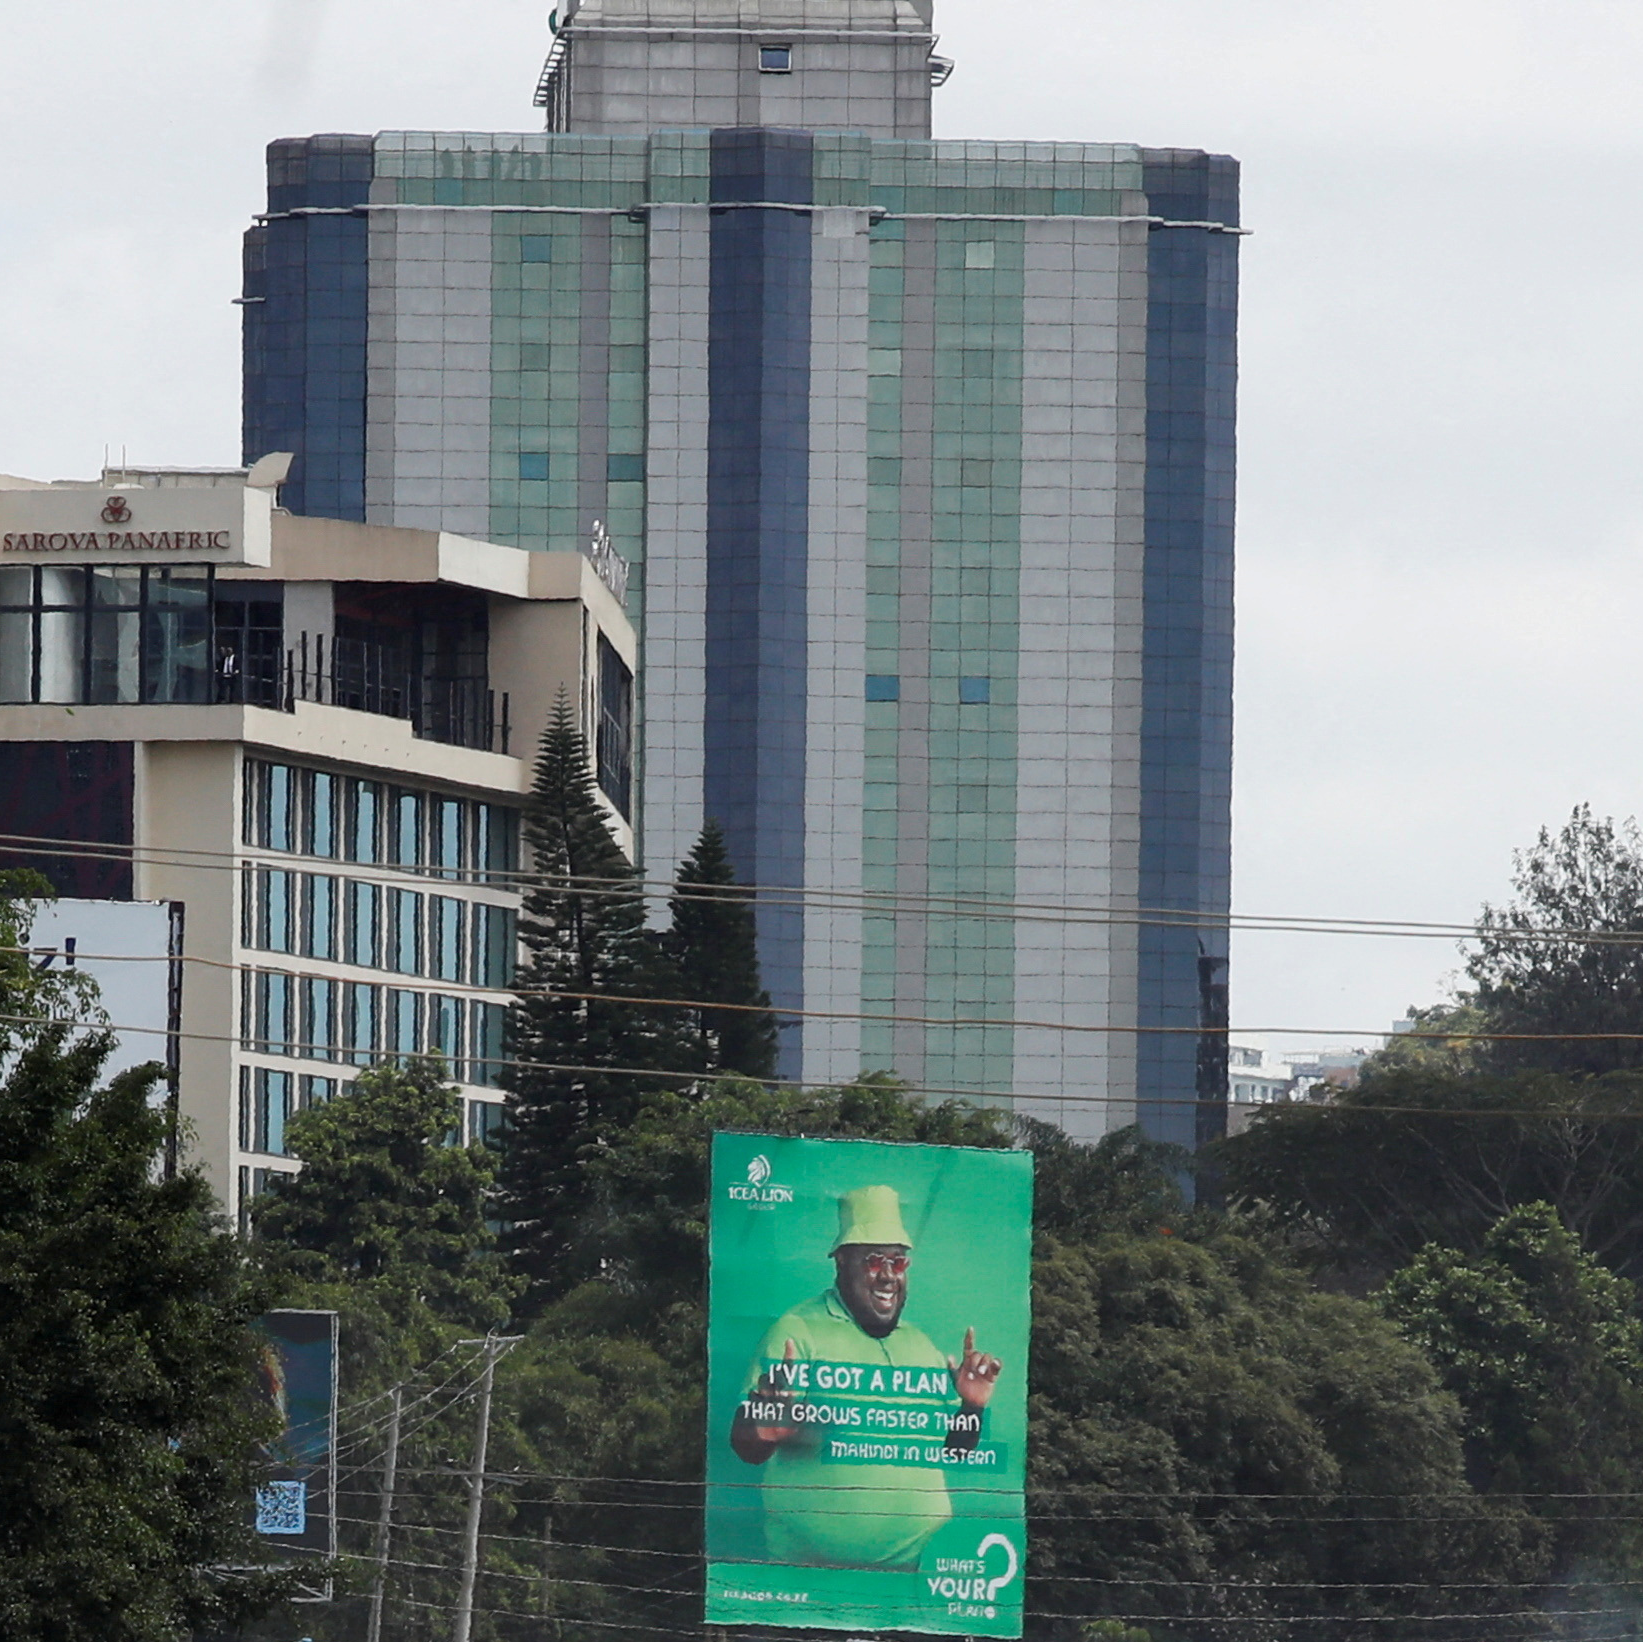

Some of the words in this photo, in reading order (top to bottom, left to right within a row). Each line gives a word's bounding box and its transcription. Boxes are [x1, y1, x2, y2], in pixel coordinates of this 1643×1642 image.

[3, 532, 101, 551] SAROVA
[103, 530, 230, 550] PANAFRIC
[728, 1187, 758, 1200] ICEA
[761, 1189, 793, 1202] LION
[769, 1363, 809, 1388] I'VE
[817, 1366, 863, 1389] GOT
[870, 1369, 885, 1391] A
[892, 1370, 948, 1394] PLAN
[742, 1400, 785, 1421] THAT
[791, 1403, 861, 1426] GROWS
[866, 1407, 929, 1430] FASTER
[927, 1578, 986, 1601] YOUR
